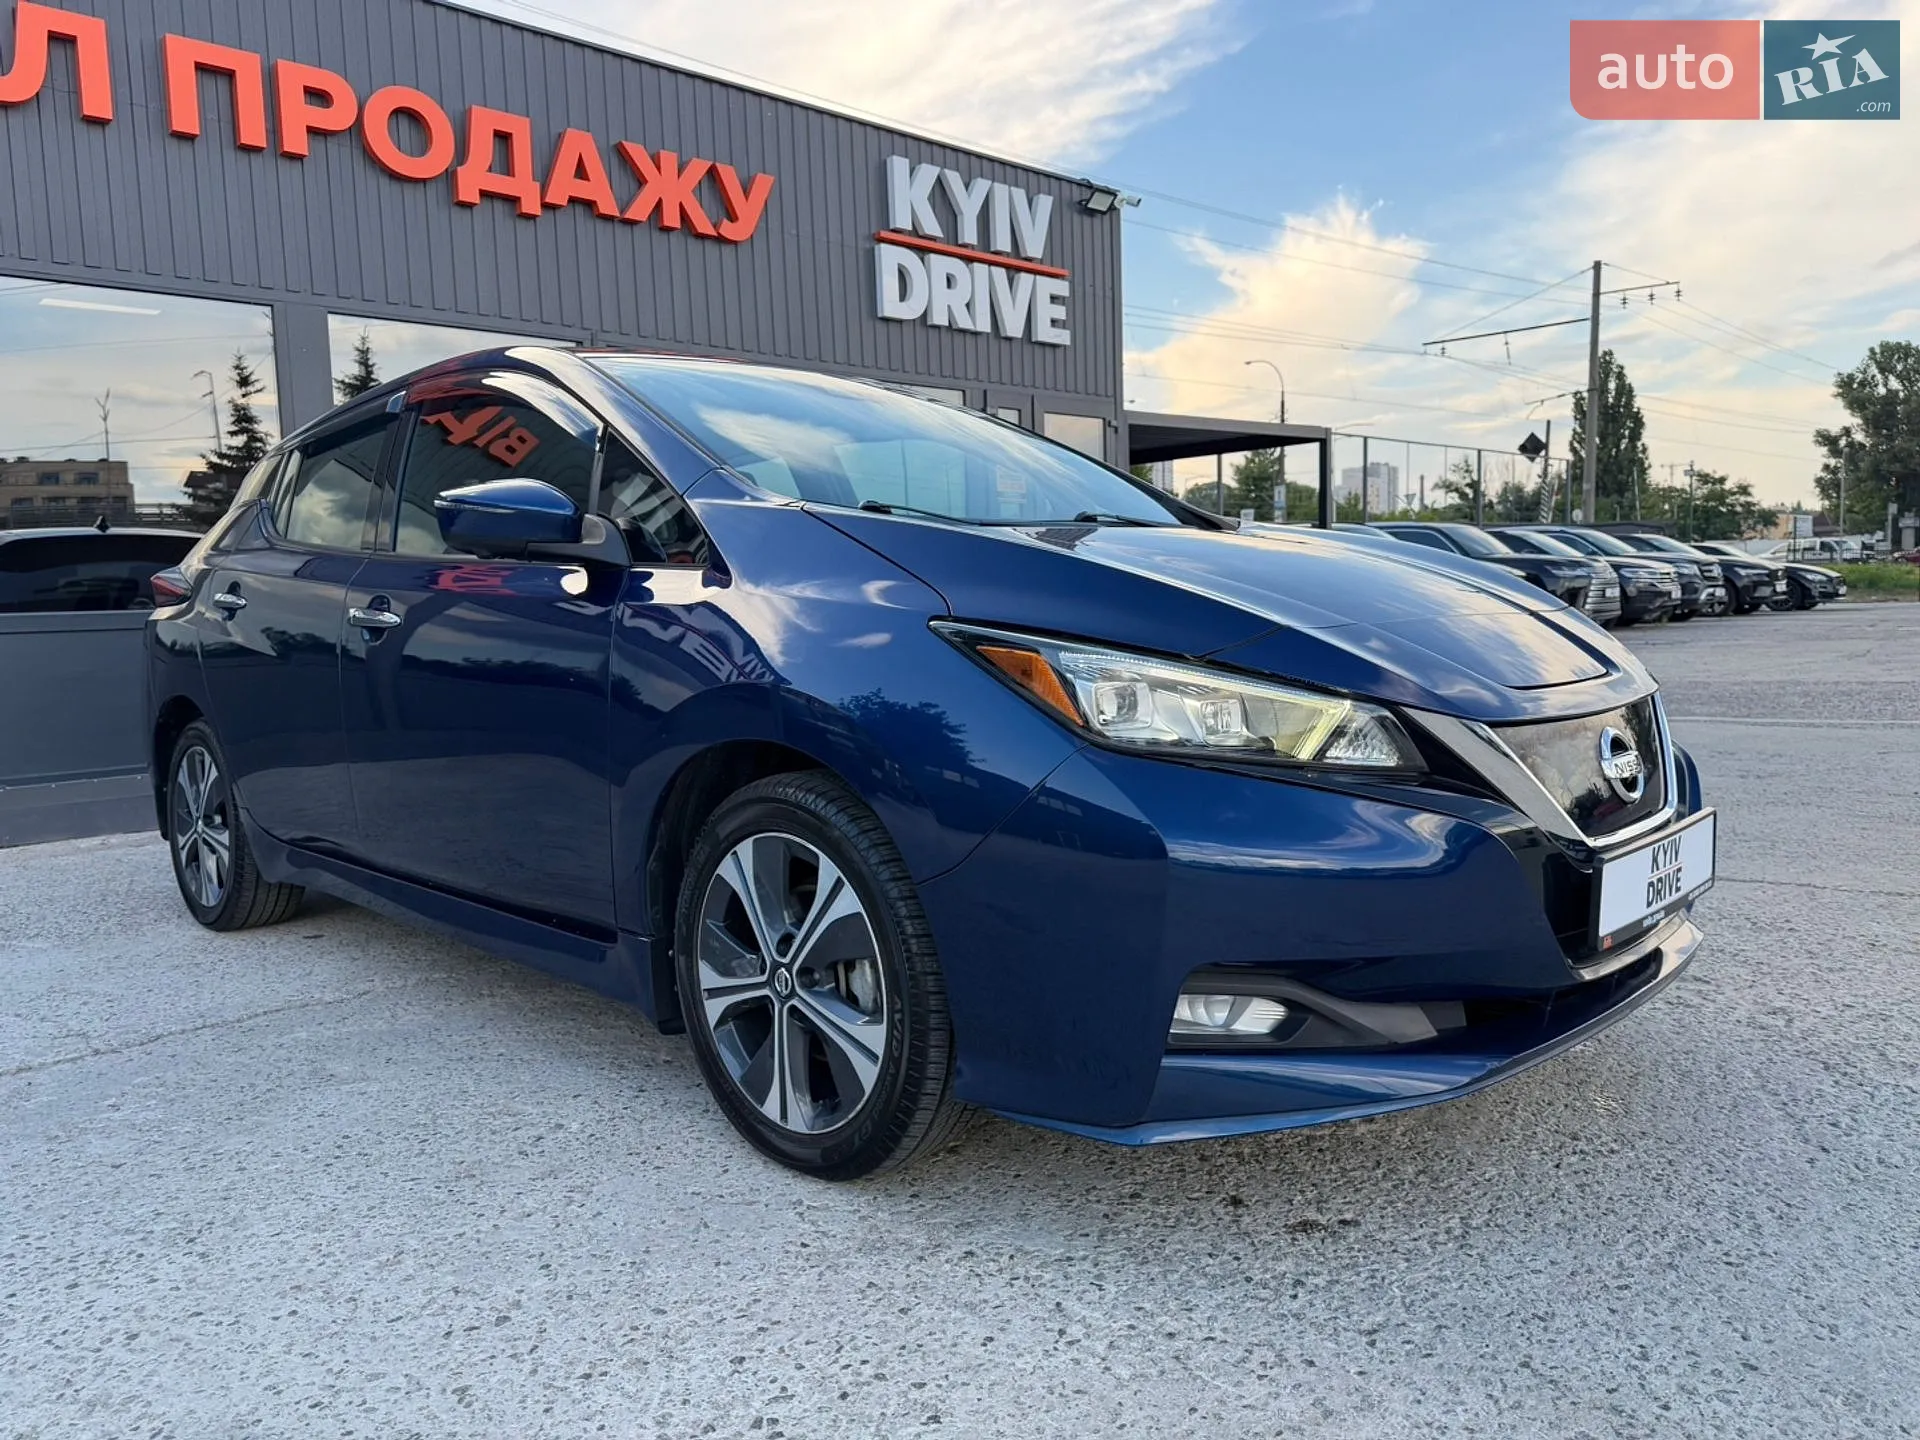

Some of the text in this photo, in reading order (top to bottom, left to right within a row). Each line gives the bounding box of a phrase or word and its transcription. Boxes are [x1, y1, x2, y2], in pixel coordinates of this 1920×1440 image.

[161, 33, 775, 243] ПРОДАЖУ
[886, 155, 1053, 259] KYIV
[875, 243, 1070, 346] DRIVE
[1646, 866, 1682, 908] DRIVE
[1651, 835, 1682, 874] KYIV
